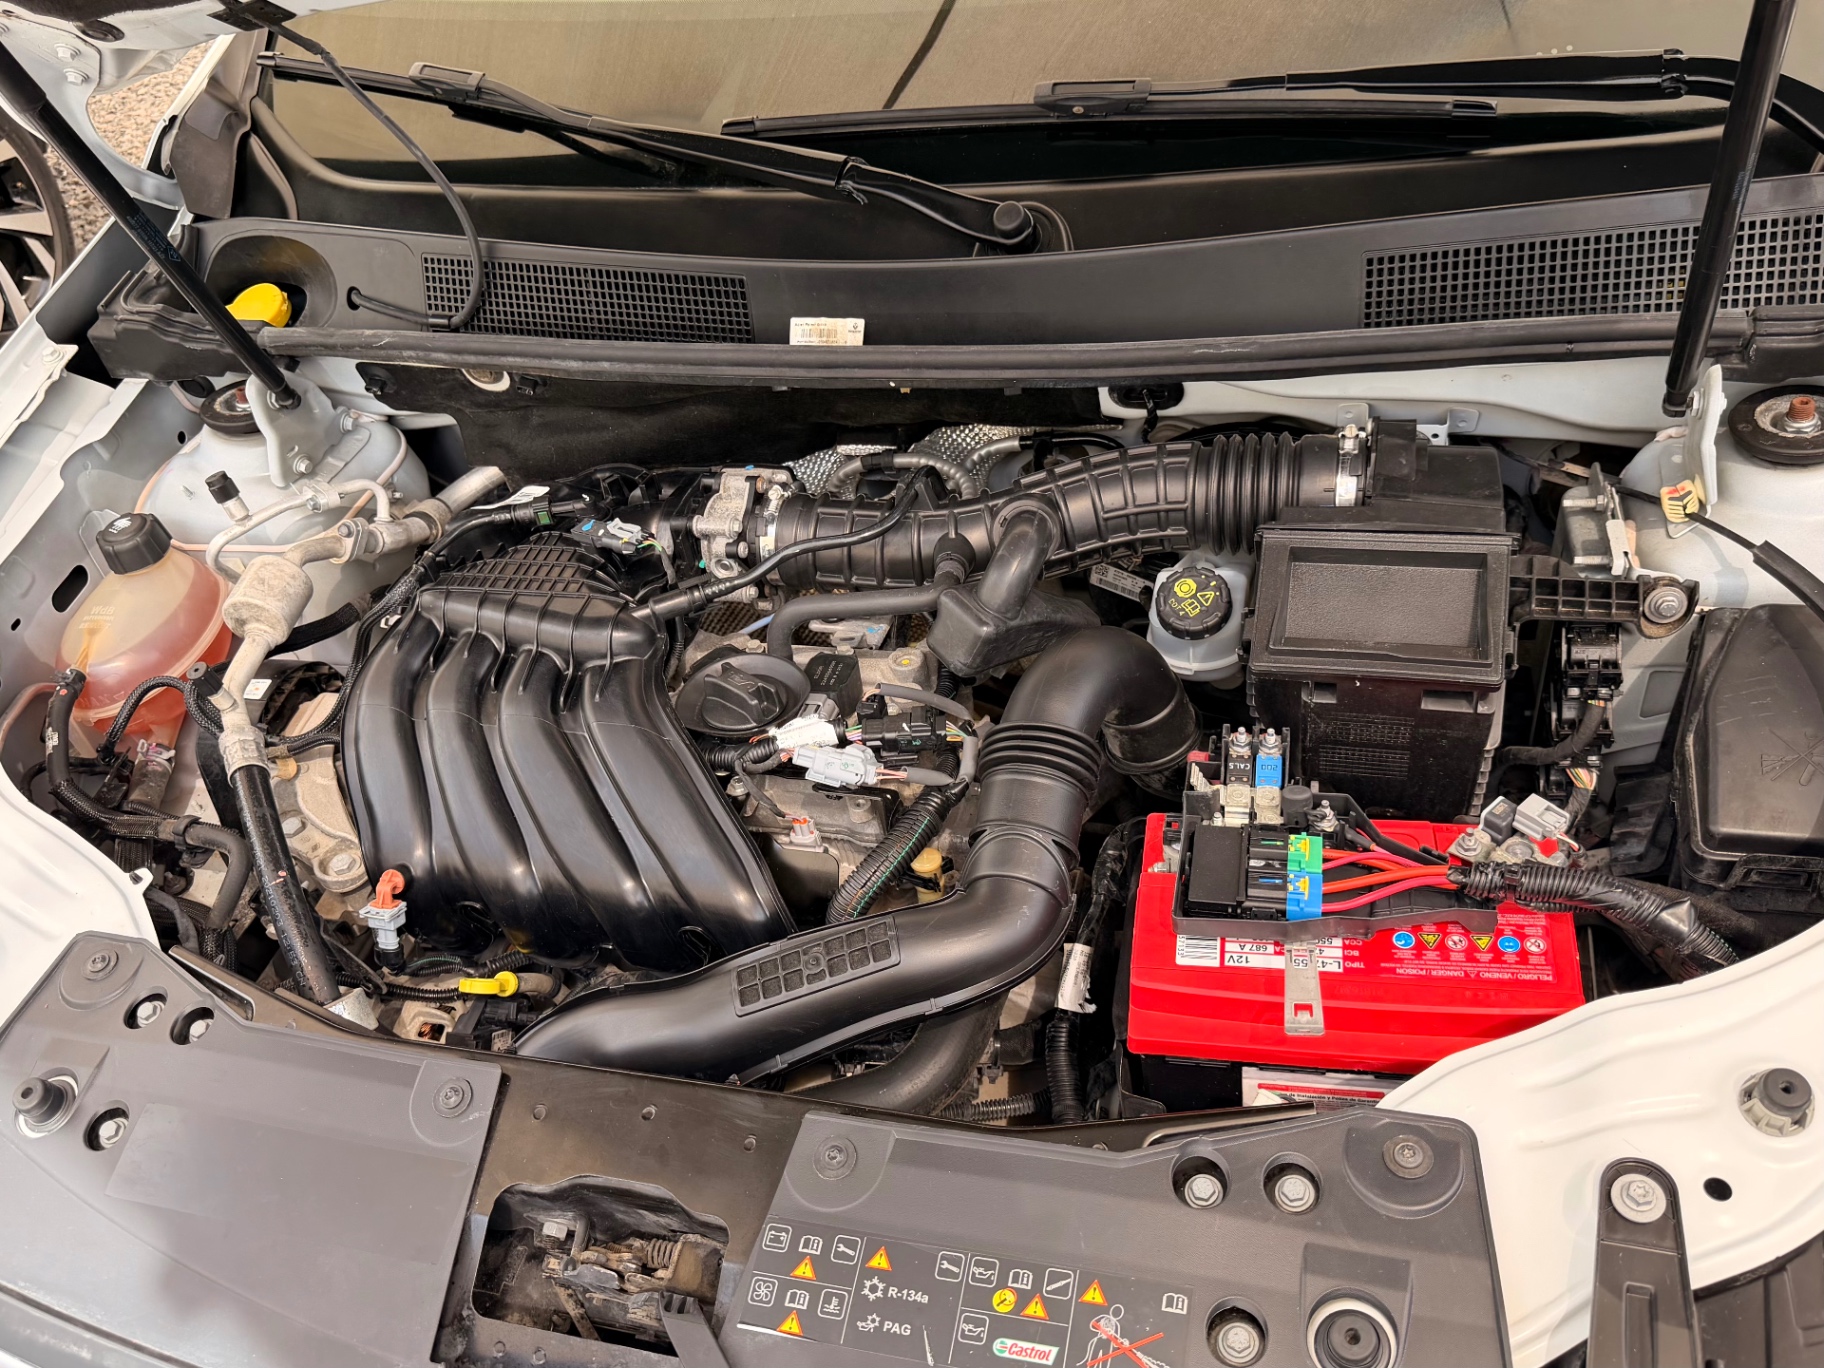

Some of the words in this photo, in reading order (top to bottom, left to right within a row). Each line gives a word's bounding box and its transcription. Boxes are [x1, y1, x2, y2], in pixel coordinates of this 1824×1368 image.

[1238, 943, 1247, 951] A
[1248, 944, 1268, 952] 687
[1227, 955, 1250, 964] 12V
[1396, 967, 1426, 975] POISON
[1431, 969, 1465, 977] DANGER
[1480, 971, 1512, 979] VENENO
[1517, 972, 1553, 981] PELIGRO
[887, 1286, 929, 1304] R-134a
[883, 1321, 912, 1336] PAG
[1007, 1342, 1053, 1361] Castrol
